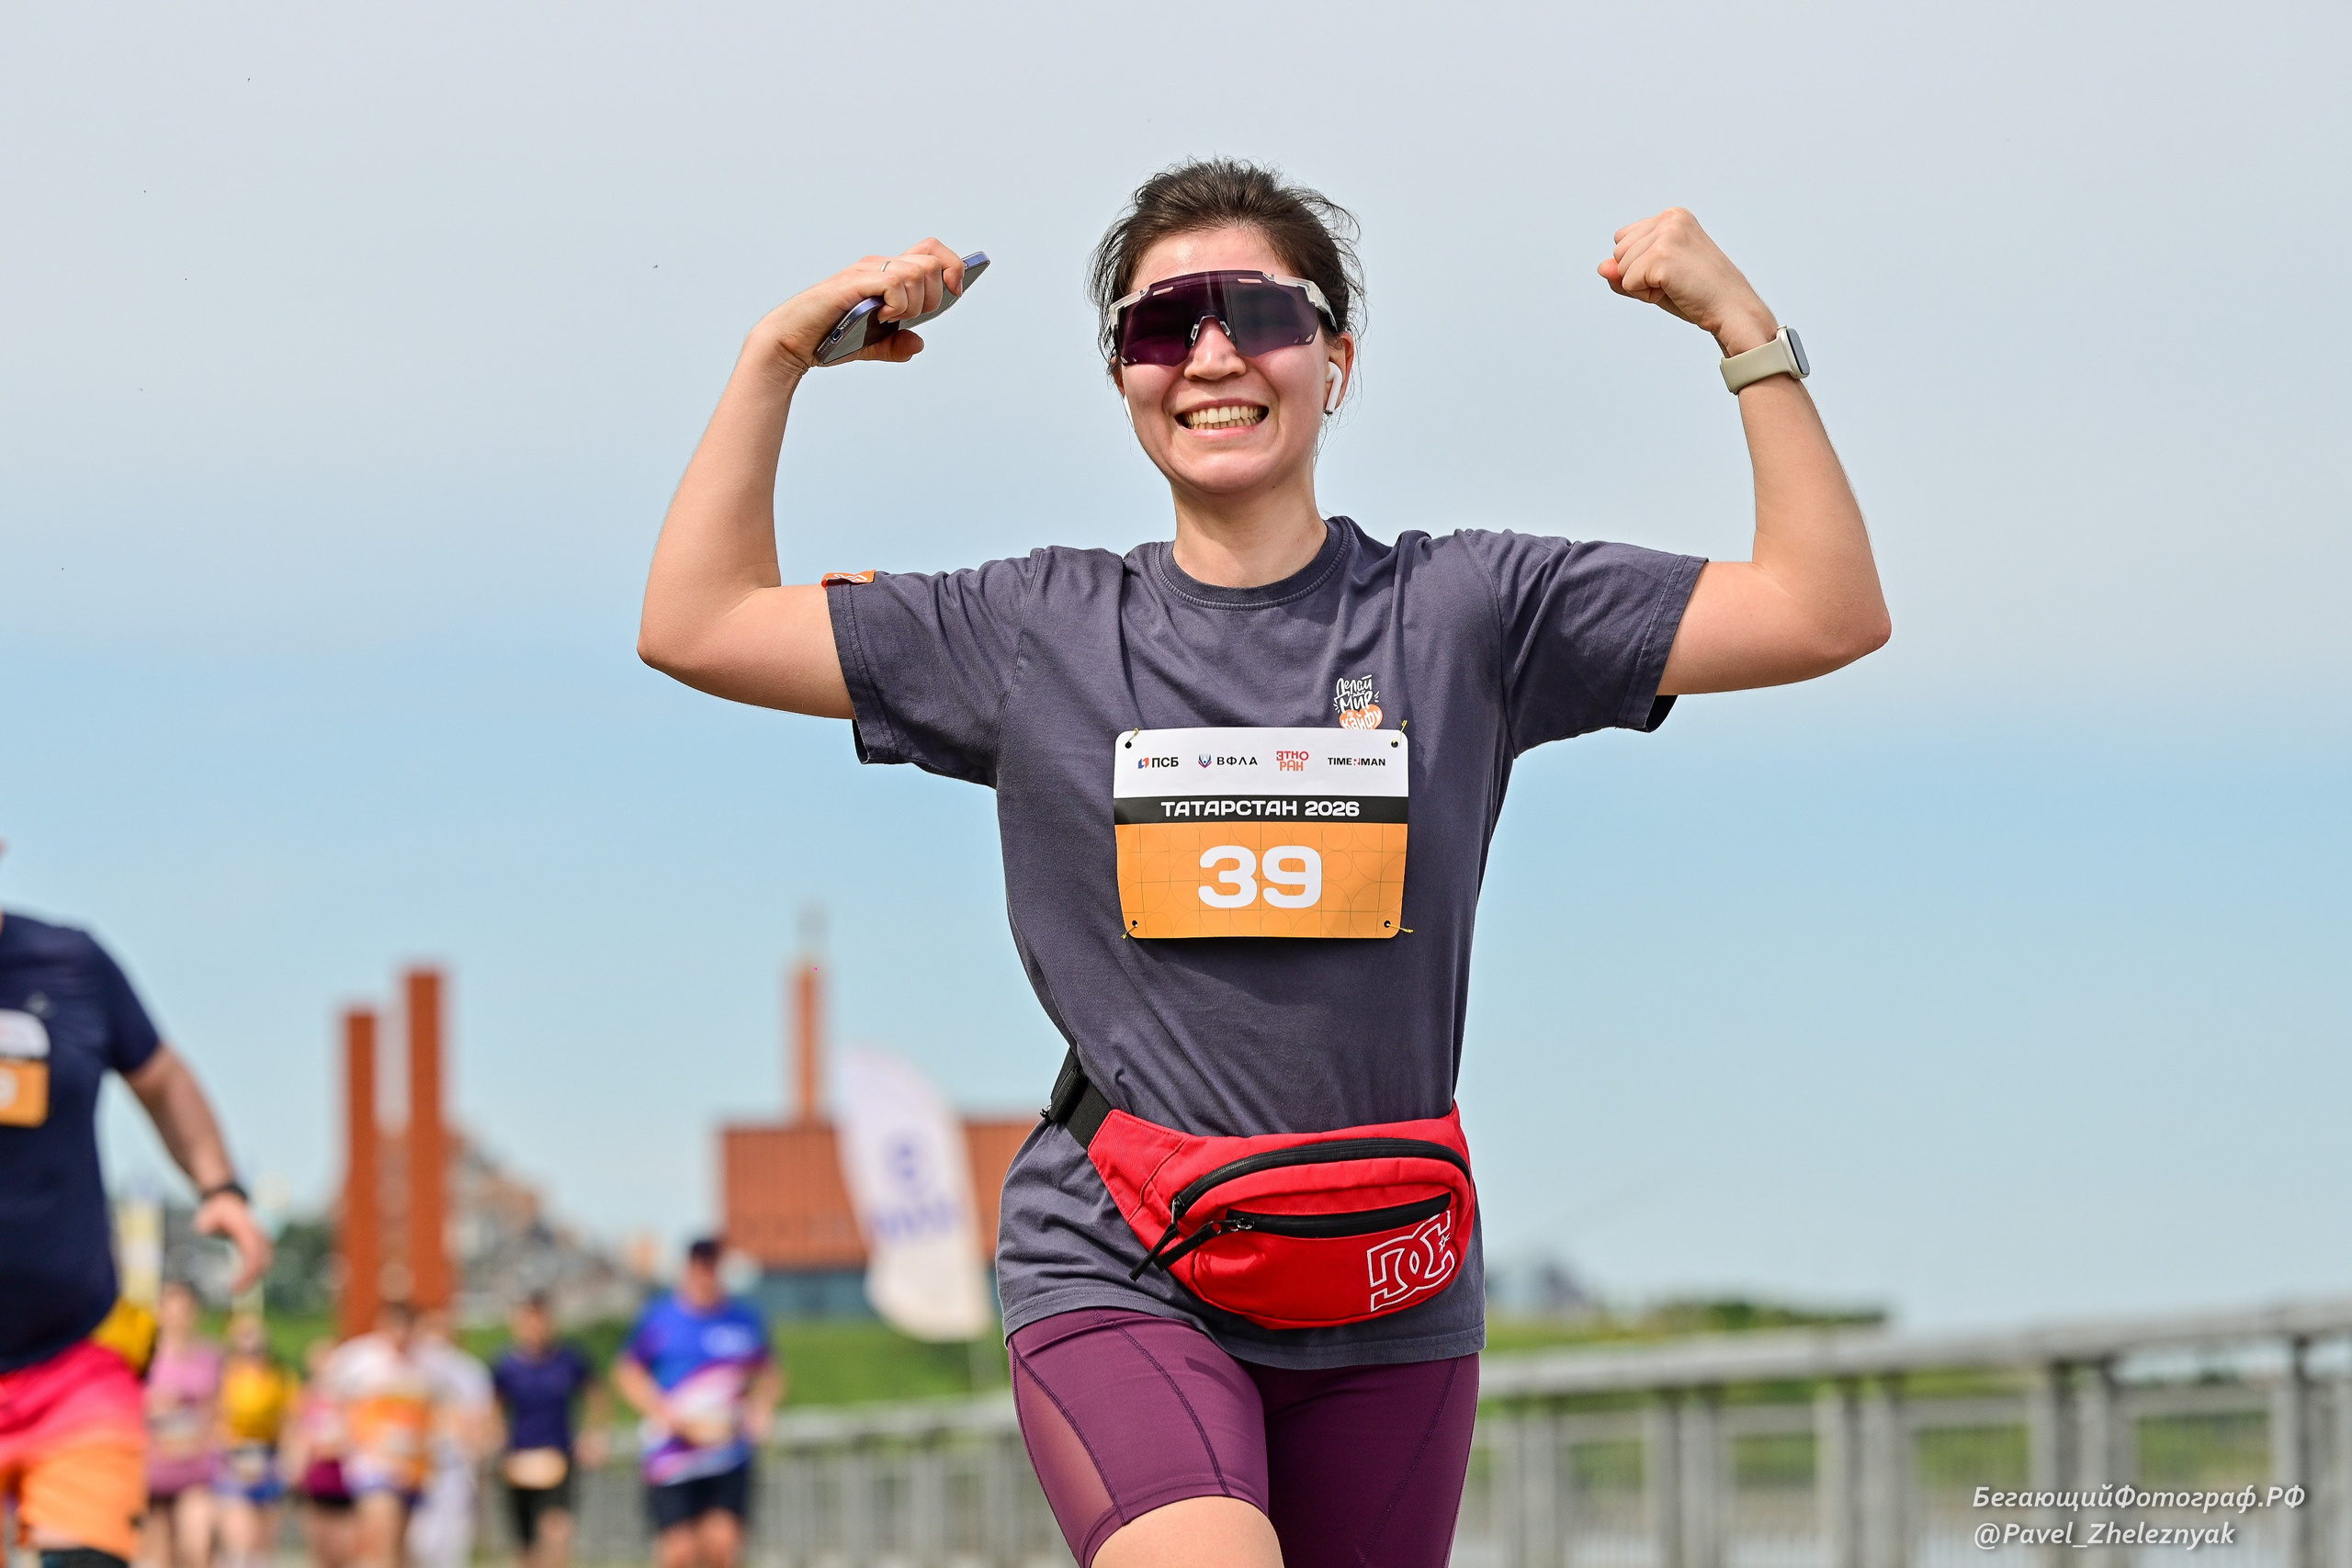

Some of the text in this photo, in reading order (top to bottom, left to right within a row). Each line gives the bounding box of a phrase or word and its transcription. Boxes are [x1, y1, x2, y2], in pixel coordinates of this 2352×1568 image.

[1334, 674, 1373, 704] Делай
[1151, 757, 1179, 768] ПСБ
[1216, 756, 1258, 766] ВФЛА
[1279, 760, 1304, 771] РАН
[1160, 800, 1360, 818] ТАТАРСТАН 2026
[1198, 845, 1322, 908] 39
